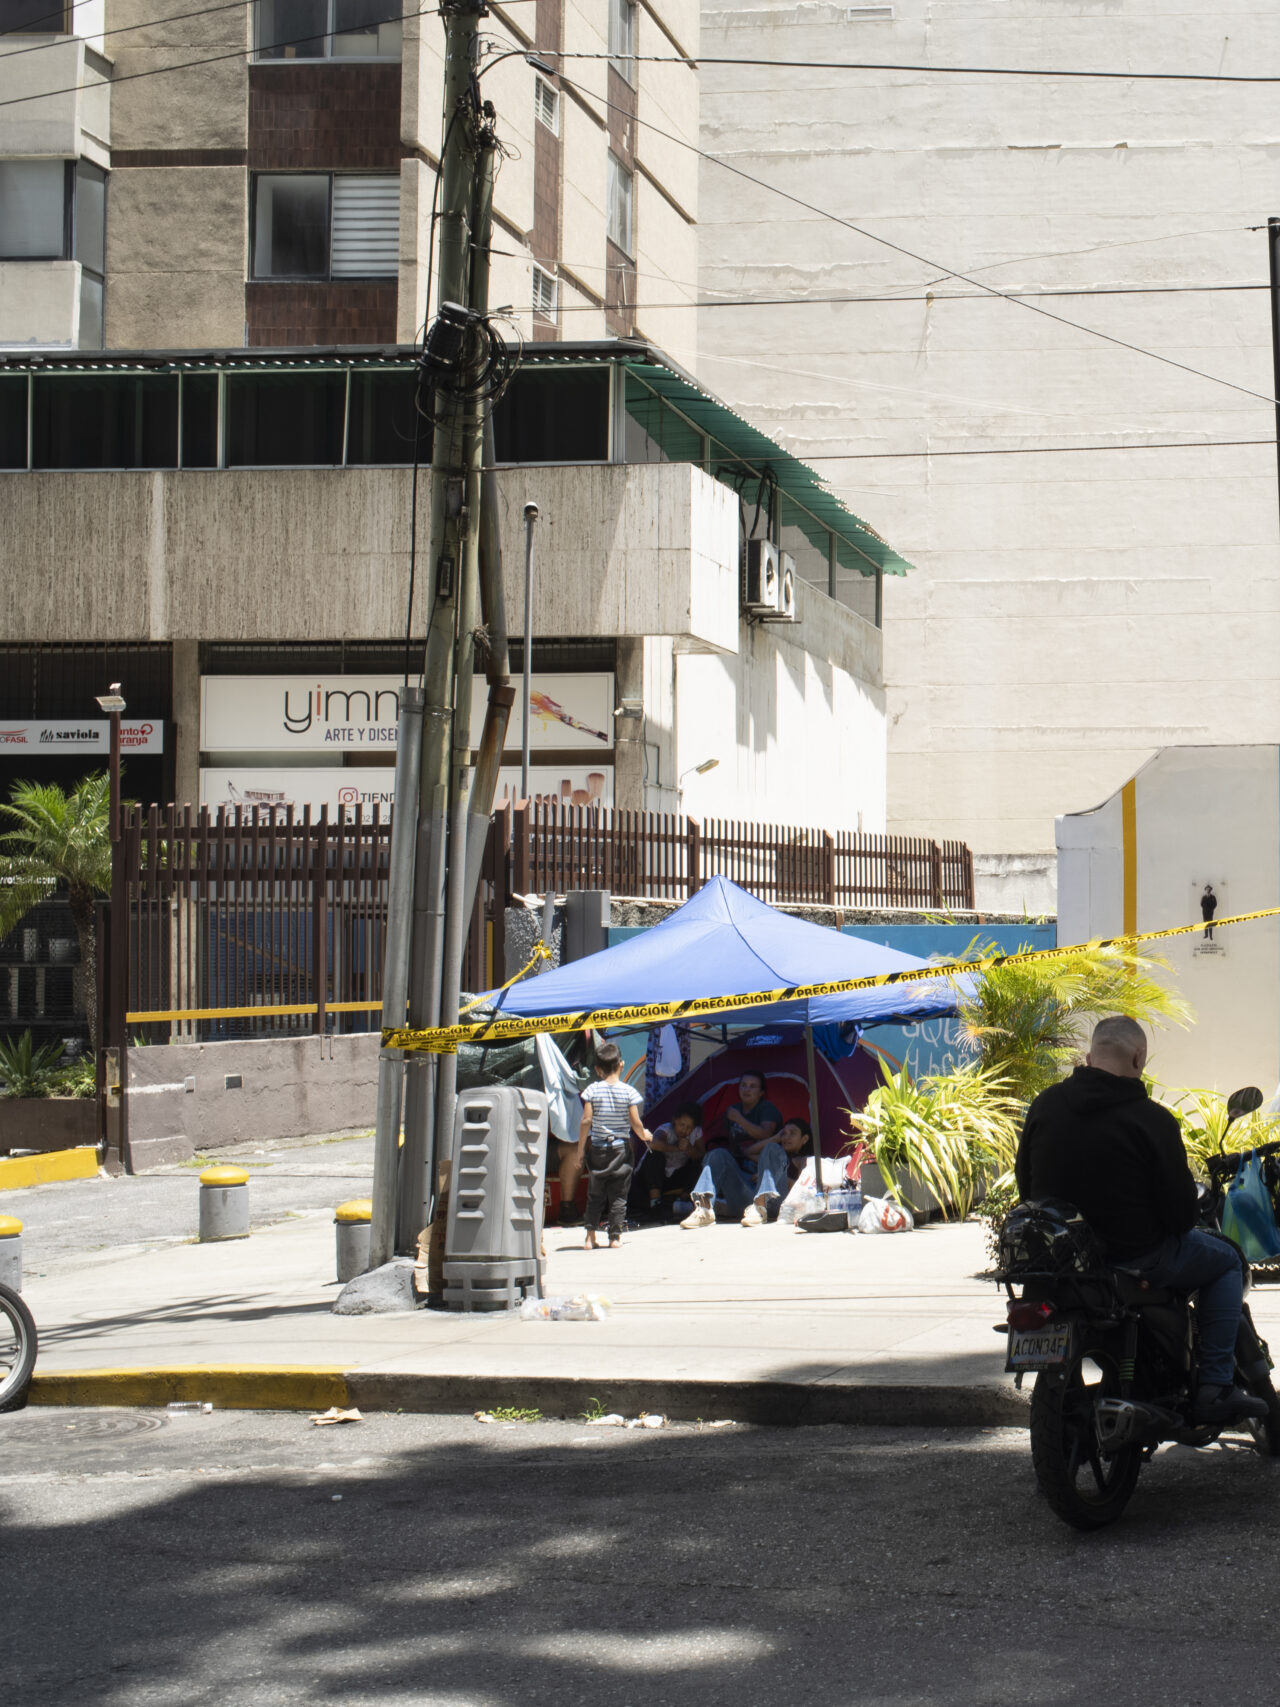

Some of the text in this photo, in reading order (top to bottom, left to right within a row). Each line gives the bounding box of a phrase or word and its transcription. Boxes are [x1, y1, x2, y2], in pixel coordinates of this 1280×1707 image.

[56, 729, 99, 740] saviola
[325, 728, 354, 741] ARTE
[358, 728, 366, 741] Y
[901, 964, 981, 982] PRECAUCION
[797, 979, 876, 997] PRECAUCION
[694, 993, 772, 1010] PRECAUCION
[593, 1005, 669, 1021] PRECAUCION
[495, 1017, 568, 1031] PRECAUCION
